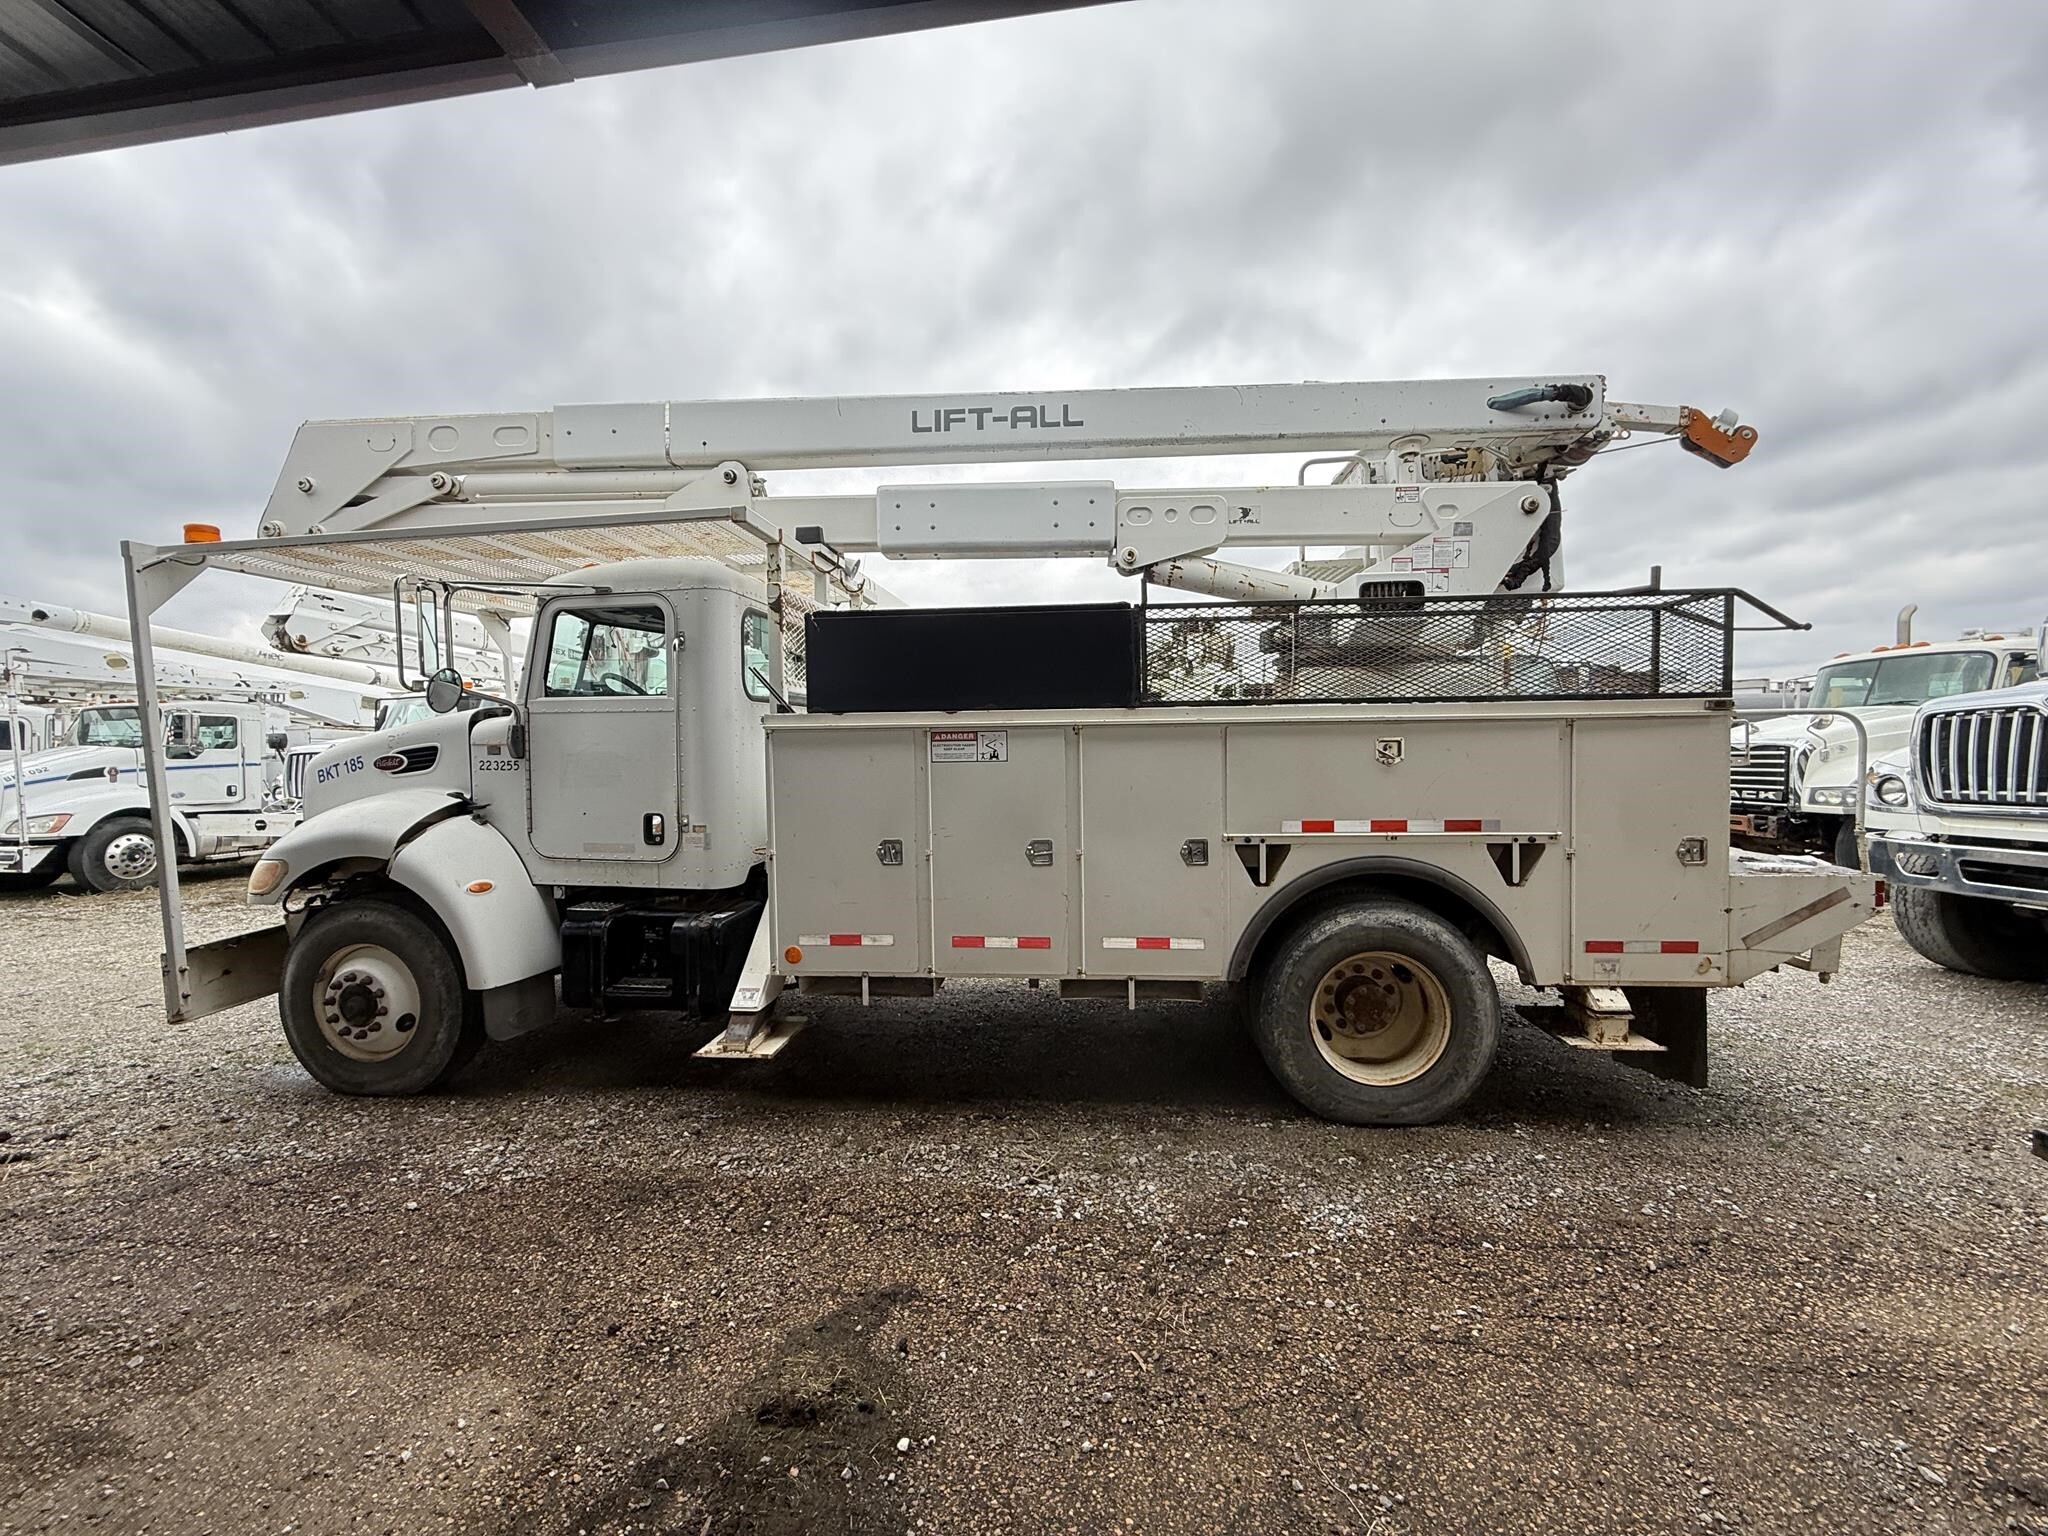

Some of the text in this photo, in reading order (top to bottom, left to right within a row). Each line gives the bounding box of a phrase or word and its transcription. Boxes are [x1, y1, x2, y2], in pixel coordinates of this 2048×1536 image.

[912, 404, 1084, 433] LIFT-ALL
[317, 755, 364, 783] BKT 185
[479, 760, 520, 771] 223255
[1730, 790, 1777, 800] ACK
